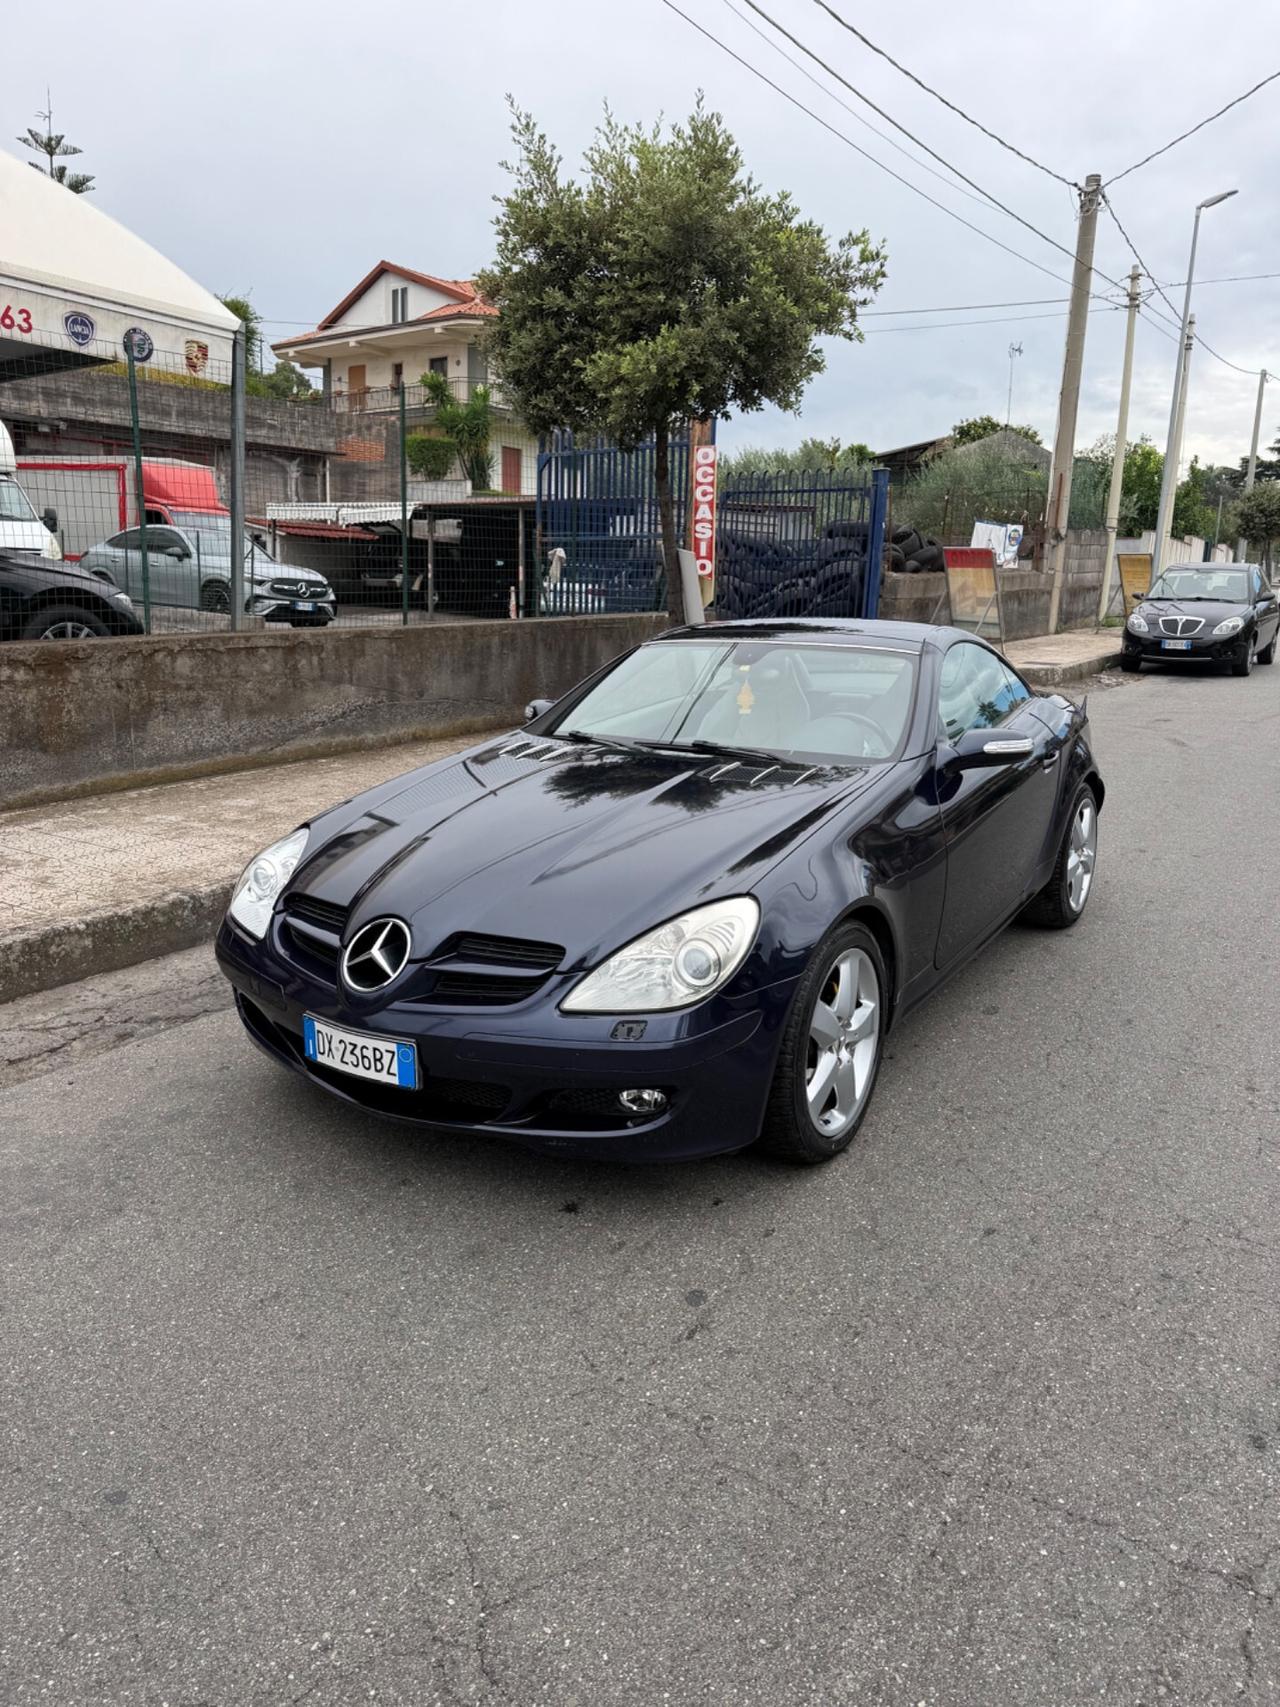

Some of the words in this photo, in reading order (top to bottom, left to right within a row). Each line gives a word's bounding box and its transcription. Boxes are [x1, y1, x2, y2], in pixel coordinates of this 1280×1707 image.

[0, 305, 33, 334] 63
[317, 1030, 335, 1060] DX
[339, 1039, 397, 1077] 236BZ
